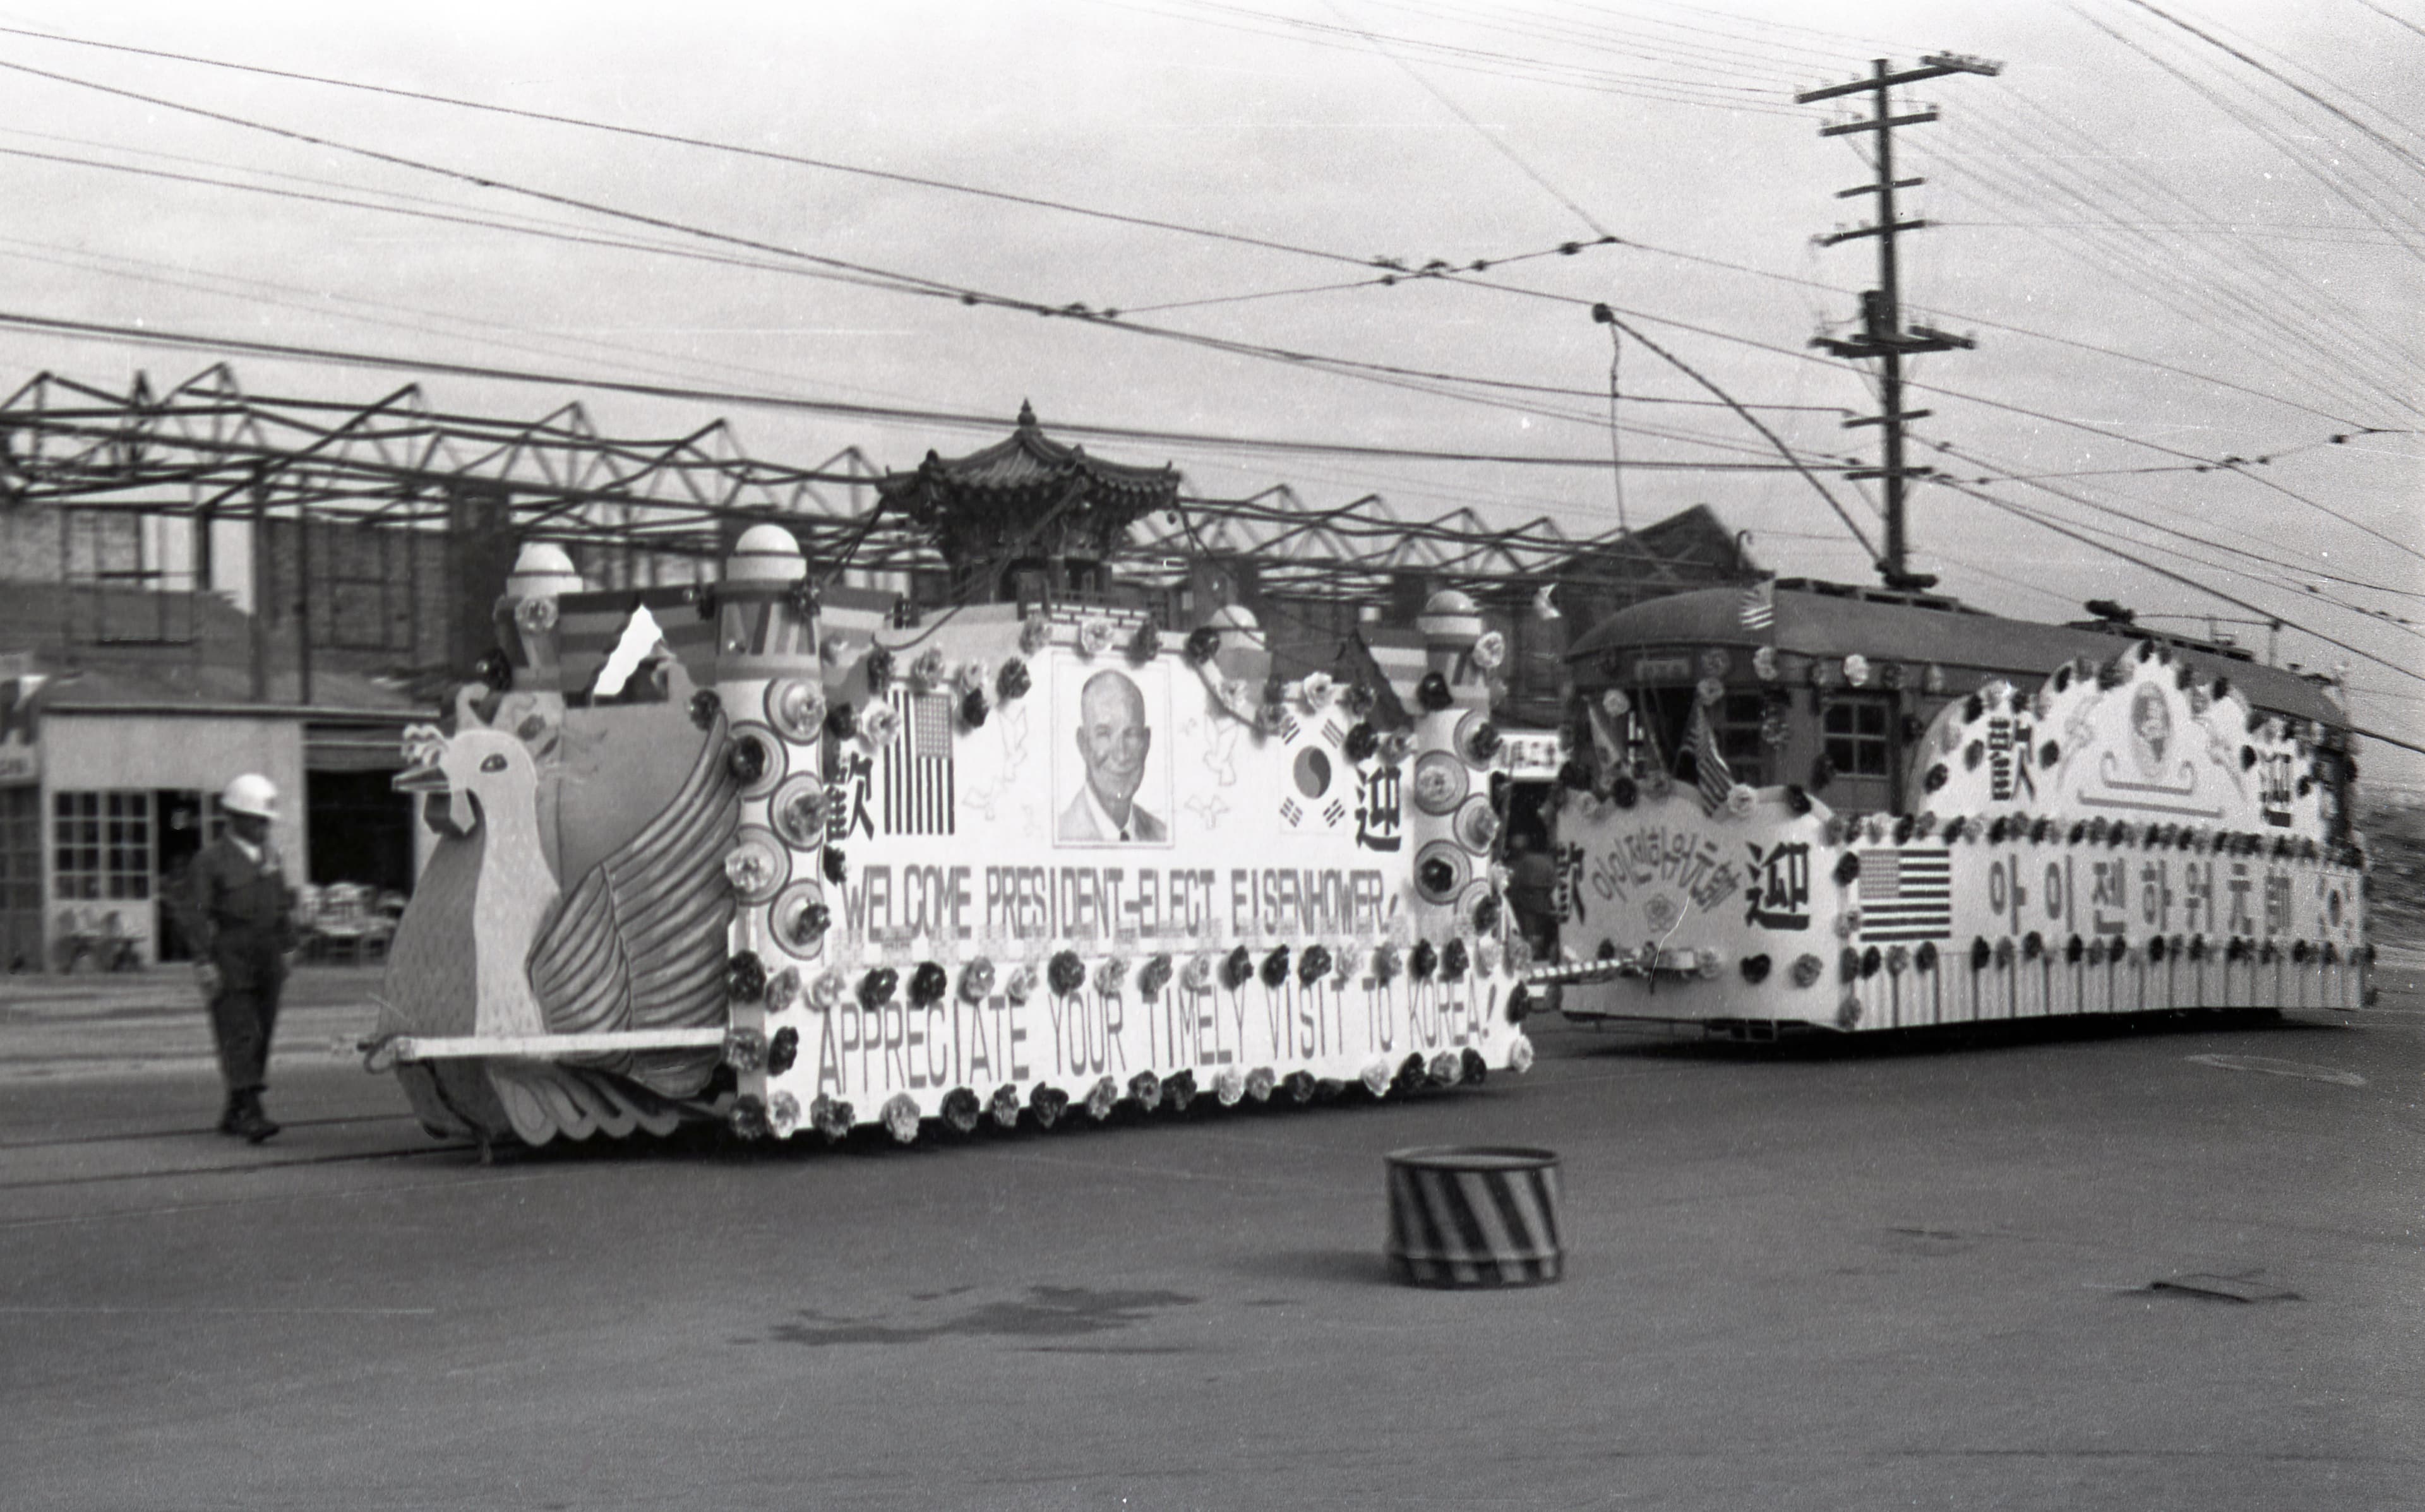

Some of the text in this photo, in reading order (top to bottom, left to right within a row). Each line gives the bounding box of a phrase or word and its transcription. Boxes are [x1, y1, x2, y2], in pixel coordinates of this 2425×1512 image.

[1354, 766, 1401, 852] 迎
[841, 864, 971, 943] WELCOME
[986, 866, 1216, 939] PRESIDENT-ELECT
[1746, 842, 1810, 930] 迎
[817, 973, 1497, 1097] APPRECIATE YOUR TIMELY VISIT TO KOREA!
